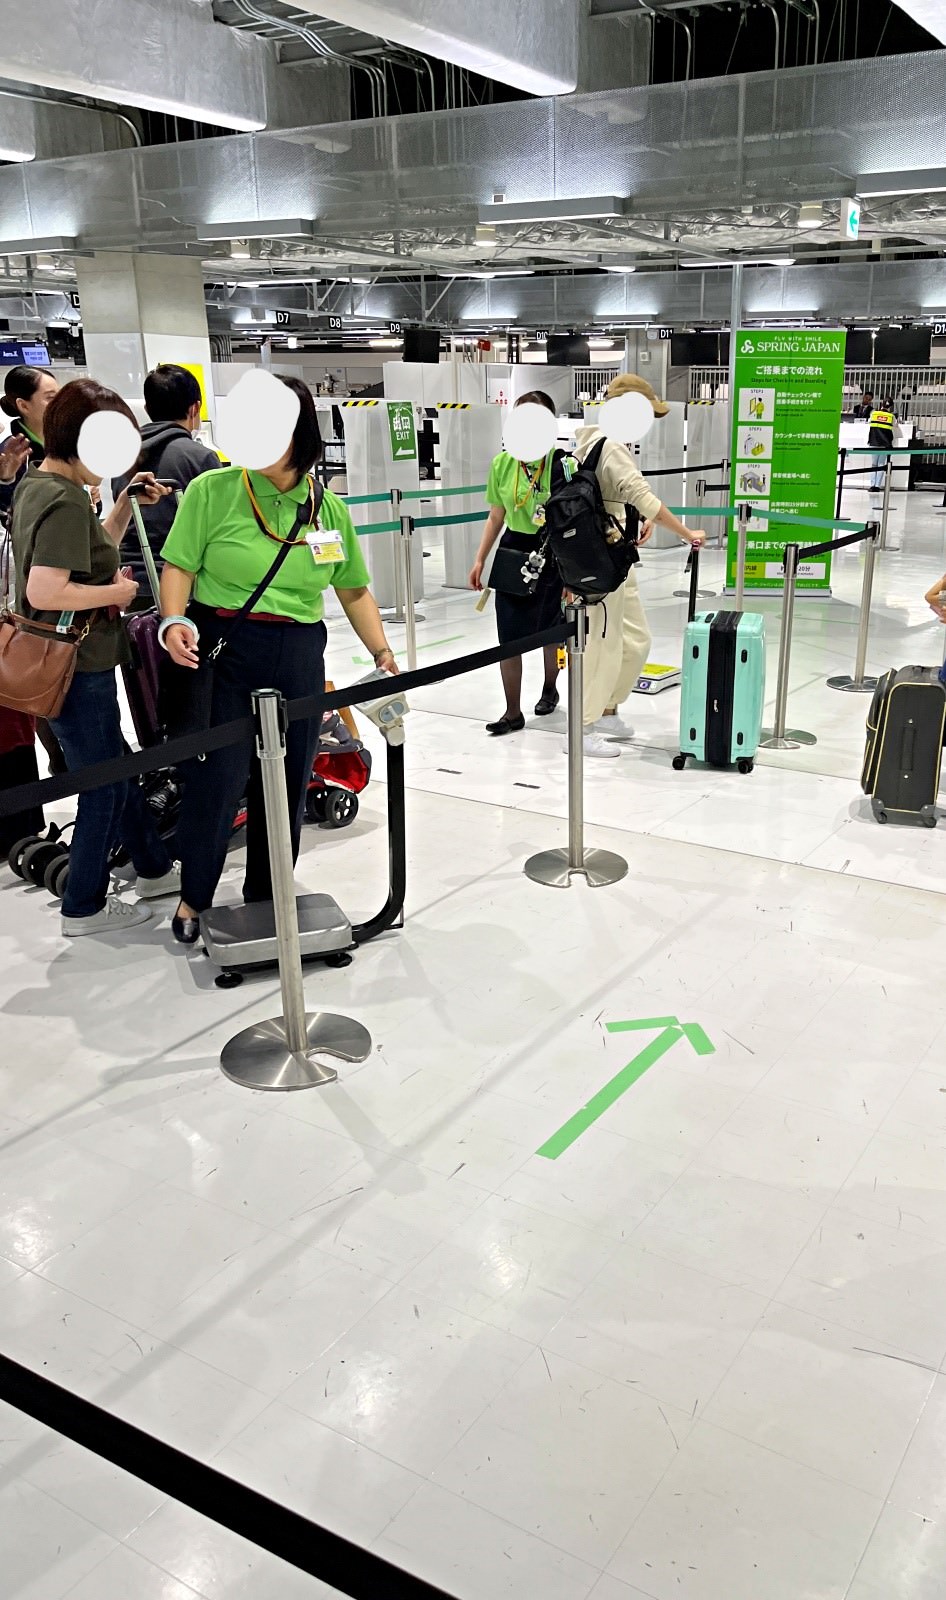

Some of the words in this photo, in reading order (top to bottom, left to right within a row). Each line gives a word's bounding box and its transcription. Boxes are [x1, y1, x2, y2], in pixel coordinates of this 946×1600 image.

[277, 312, 289, 324] D7
[329, 317, 341, 328] D8
[390, 322, 401, 333] D9
[536, 331, 548, 340] D10
[757, 341, 799, 353] SPRING
[802, 342, 840, 353] JAPAN
[755, 365, 823, 376] ご搭乗までの流れ
[396, 431, 410, 441] EXIT
